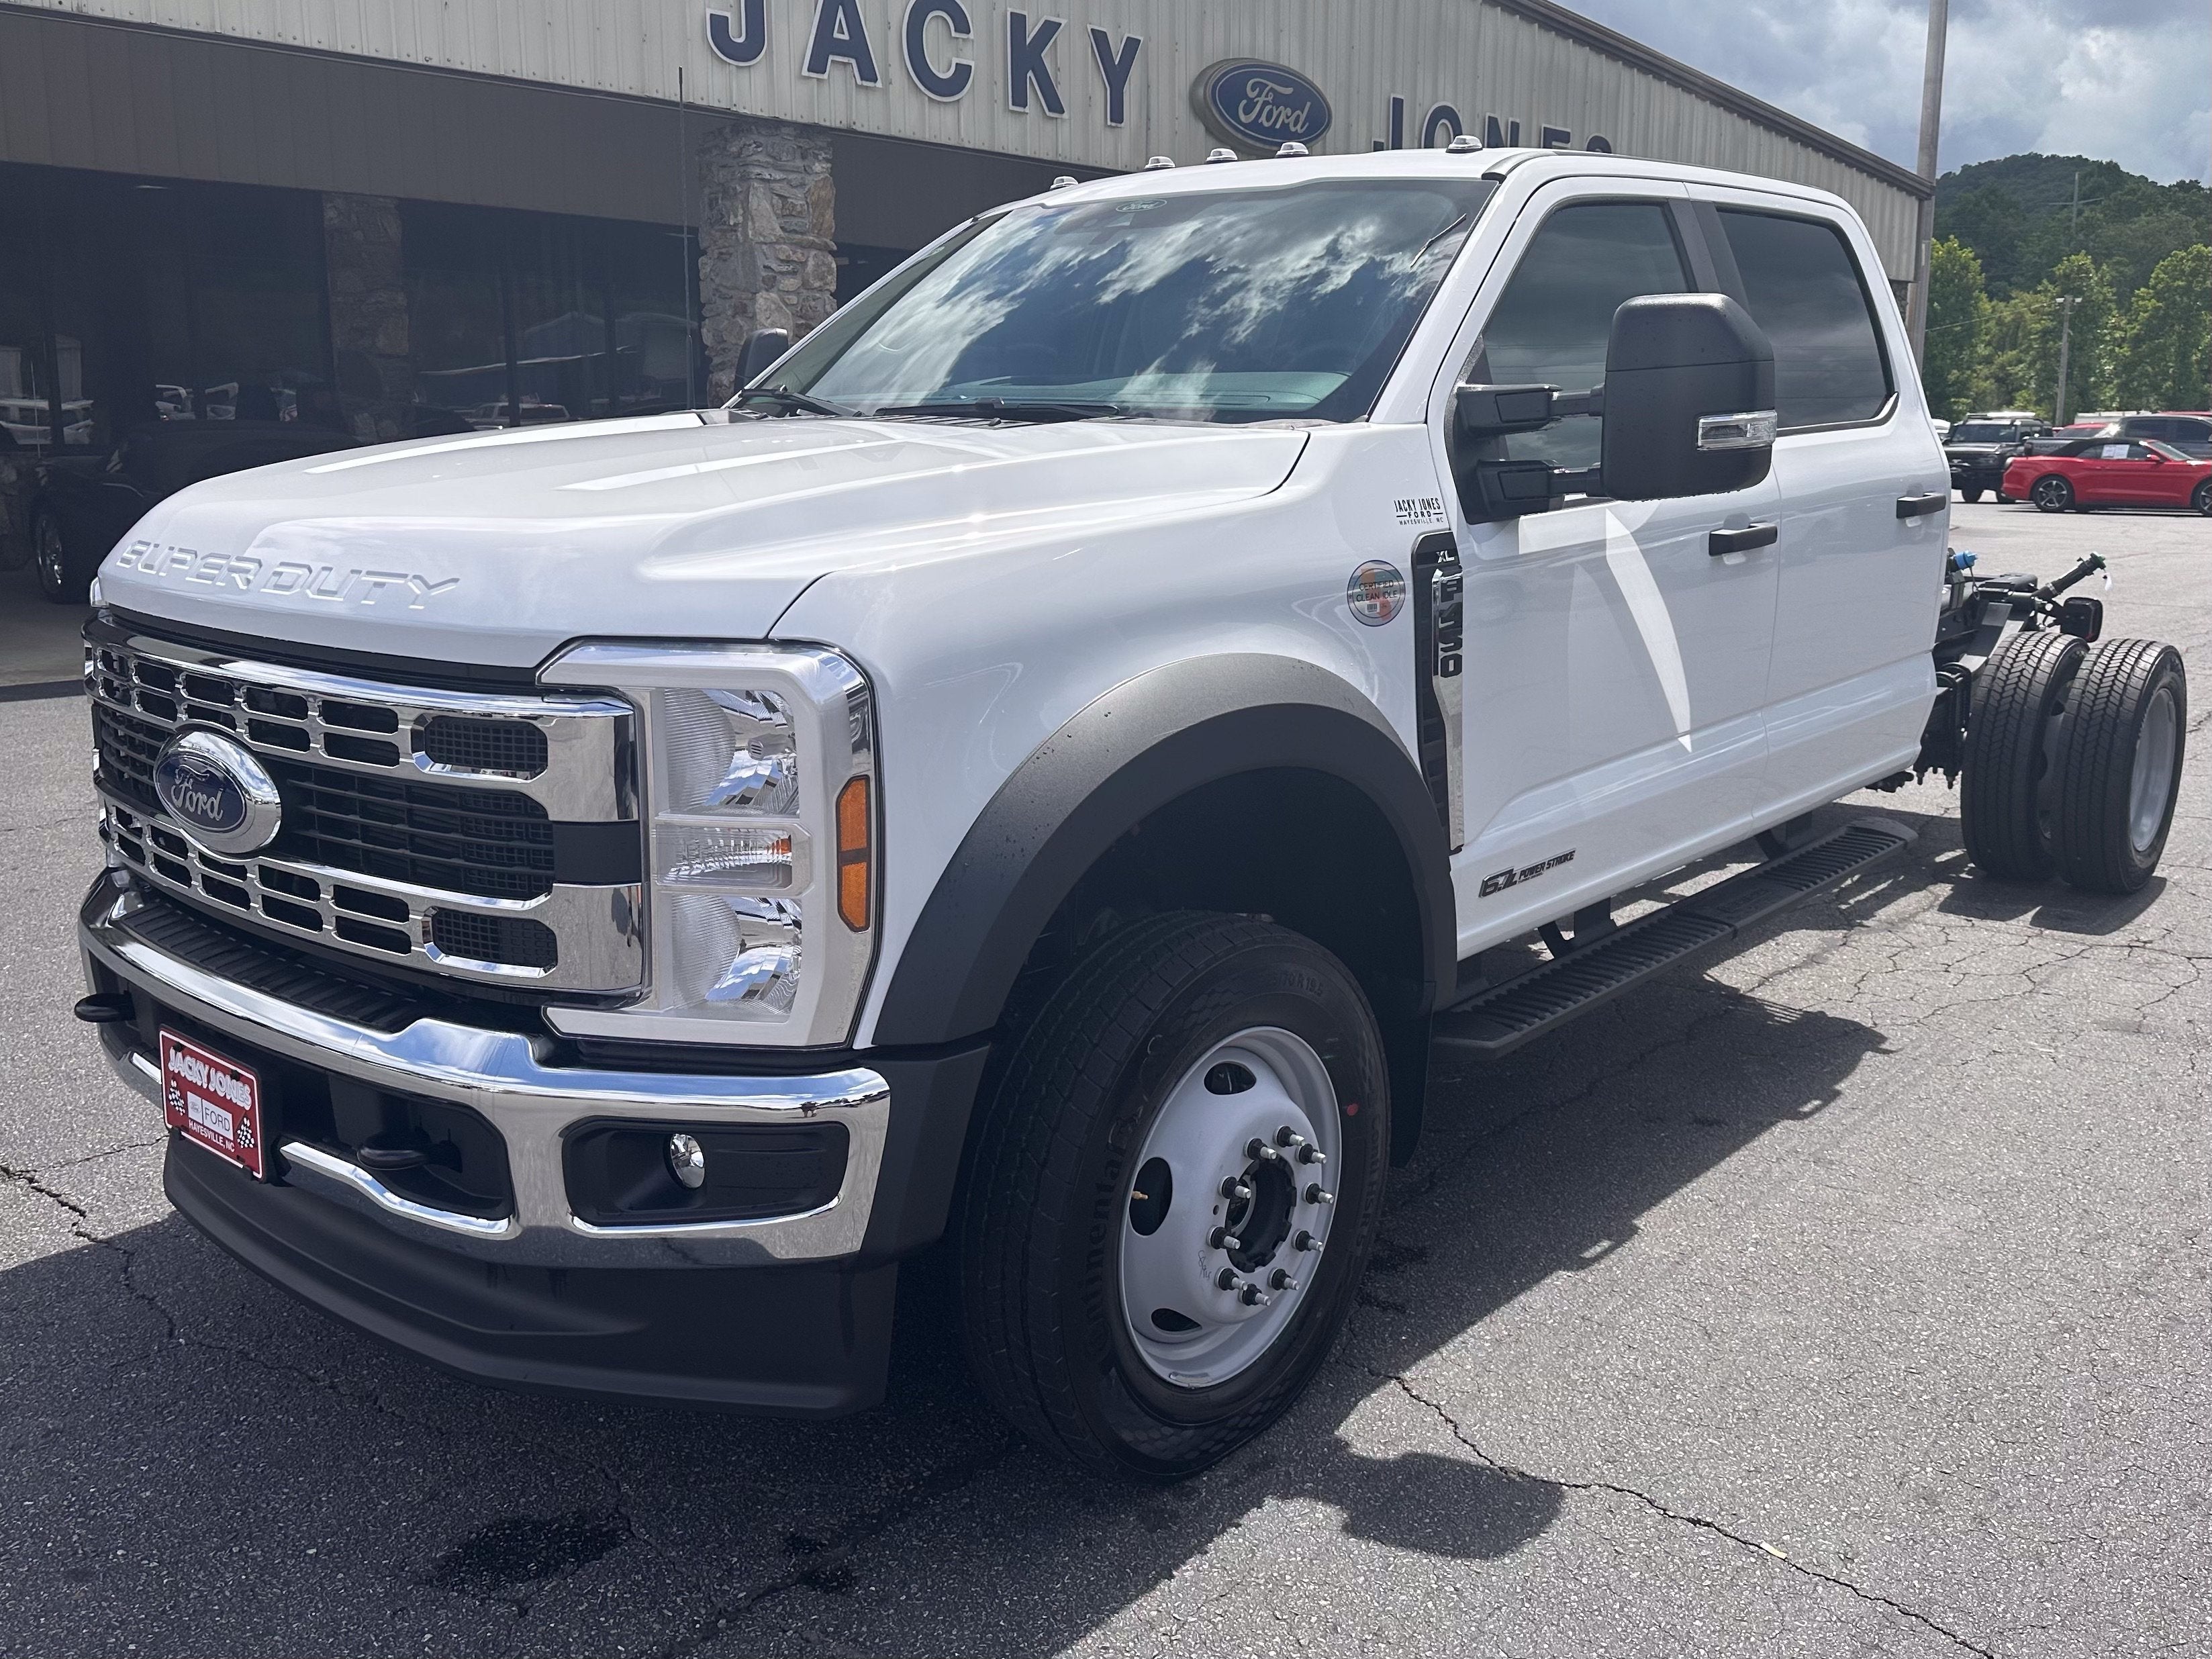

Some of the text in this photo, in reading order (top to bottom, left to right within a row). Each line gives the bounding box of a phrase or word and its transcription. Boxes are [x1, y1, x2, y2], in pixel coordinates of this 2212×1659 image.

[706, 0, 1613, 154] JACKY JON
[1238, 78, 1311, 134] Ford
[1394, 497, 1441, 513] JACKY JONES
[1408, 510, 1432, 518] FORD
[1436, 550, 1455, 563] XL
[116, 539, 461, 610] SUPER DUTY
[1359, 579, 1394, 591] CERTIFIED
[1355, 592, 1380, 602] CLEAN
[1382, 589, 1398, 600] IDLE
[171, 763, 224, 822] Ford
[1519, 861, 1545, 880] POWER
[1545, 849, 1576, 870] STROKE
[168, 1047, 252, 1110] JACKY JONES
[204, 1107, 230, 1132] FORD
[188, 1119, 235, 1153] HAYESVILLE, NC
